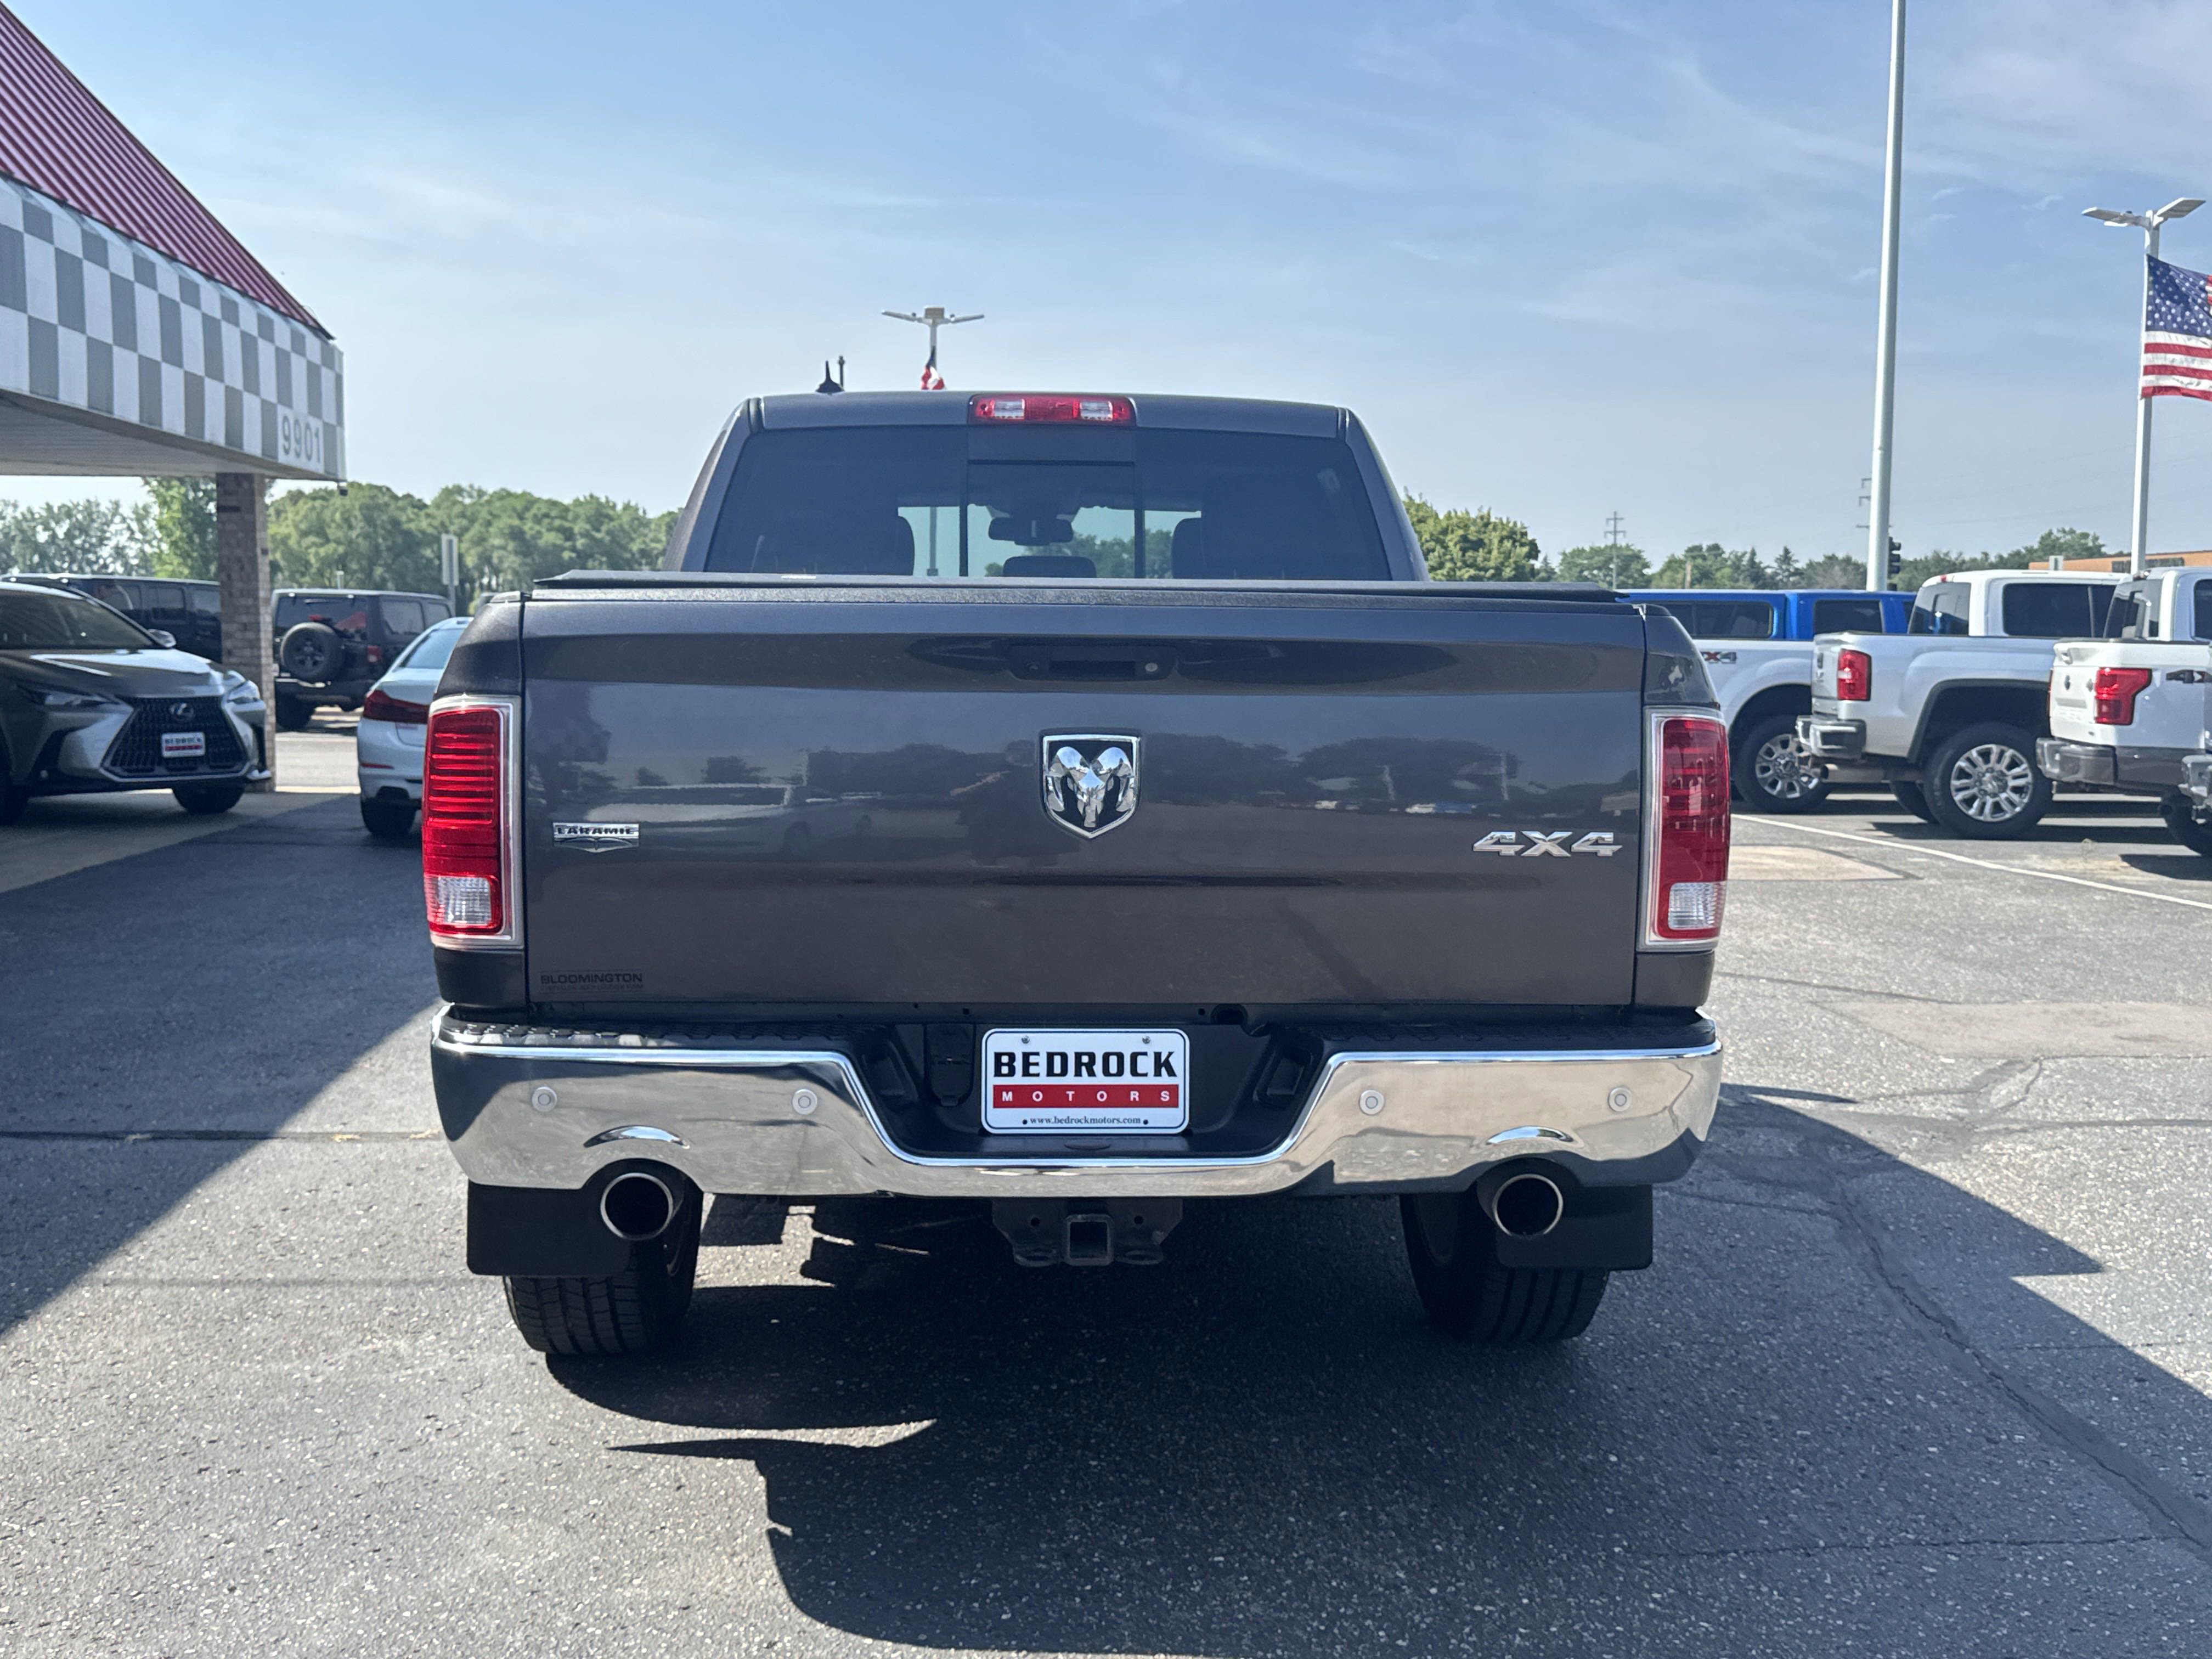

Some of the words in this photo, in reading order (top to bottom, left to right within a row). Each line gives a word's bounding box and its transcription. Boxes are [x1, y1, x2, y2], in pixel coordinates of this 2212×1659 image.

[282, 415, 320, 463] 9901
[555, 825, 638, 835] LARAMIE
[540, 973, 643, 984] BLOOMINGTON
[994, 1052, 1177, 1077] BEDROCK
[1001, 1091, 1171, 1102] MOTORS
[1030, 1116, 1141, 1125] www.bedrockmotors.com
